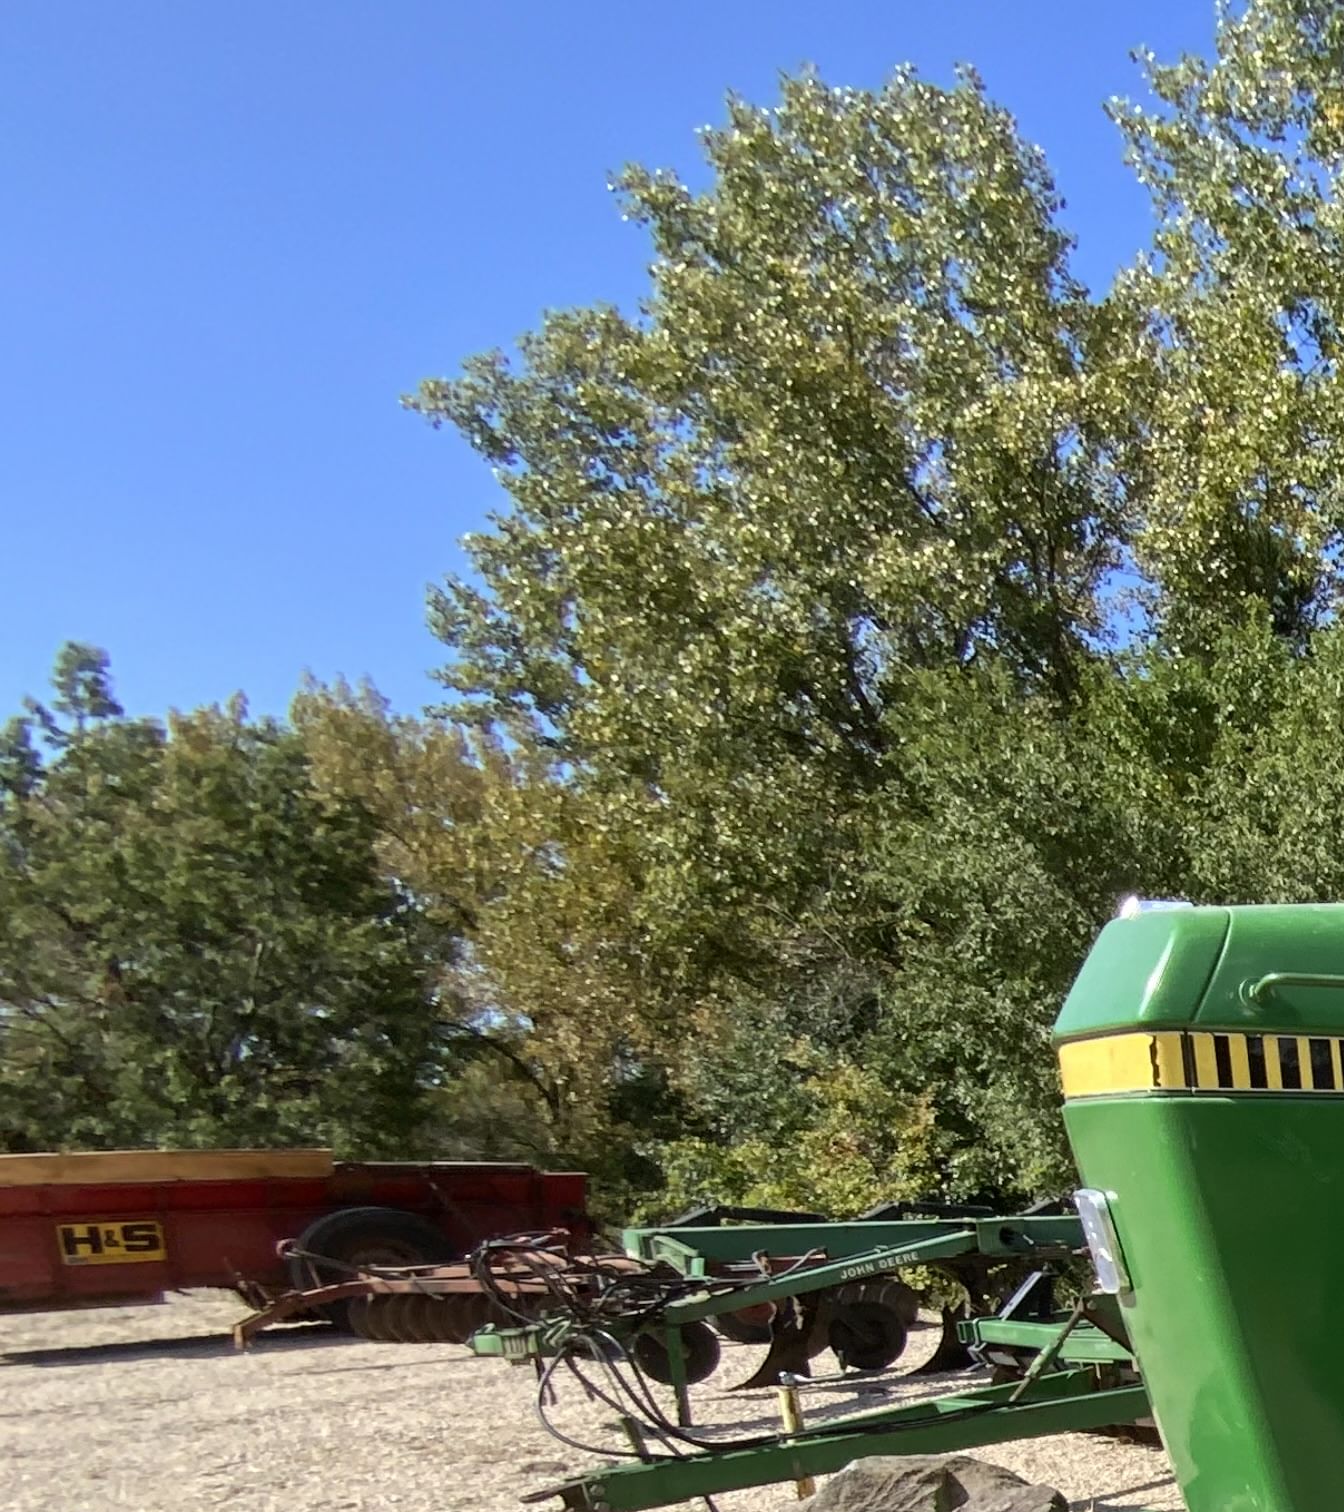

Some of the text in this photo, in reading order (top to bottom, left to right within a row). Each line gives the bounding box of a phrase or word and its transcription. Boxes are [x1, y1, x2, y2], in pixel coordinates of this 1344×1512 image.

[62, 1224, 160, 1256] H&S
[840, 1251, 919, 1280] JOHN DEERE
